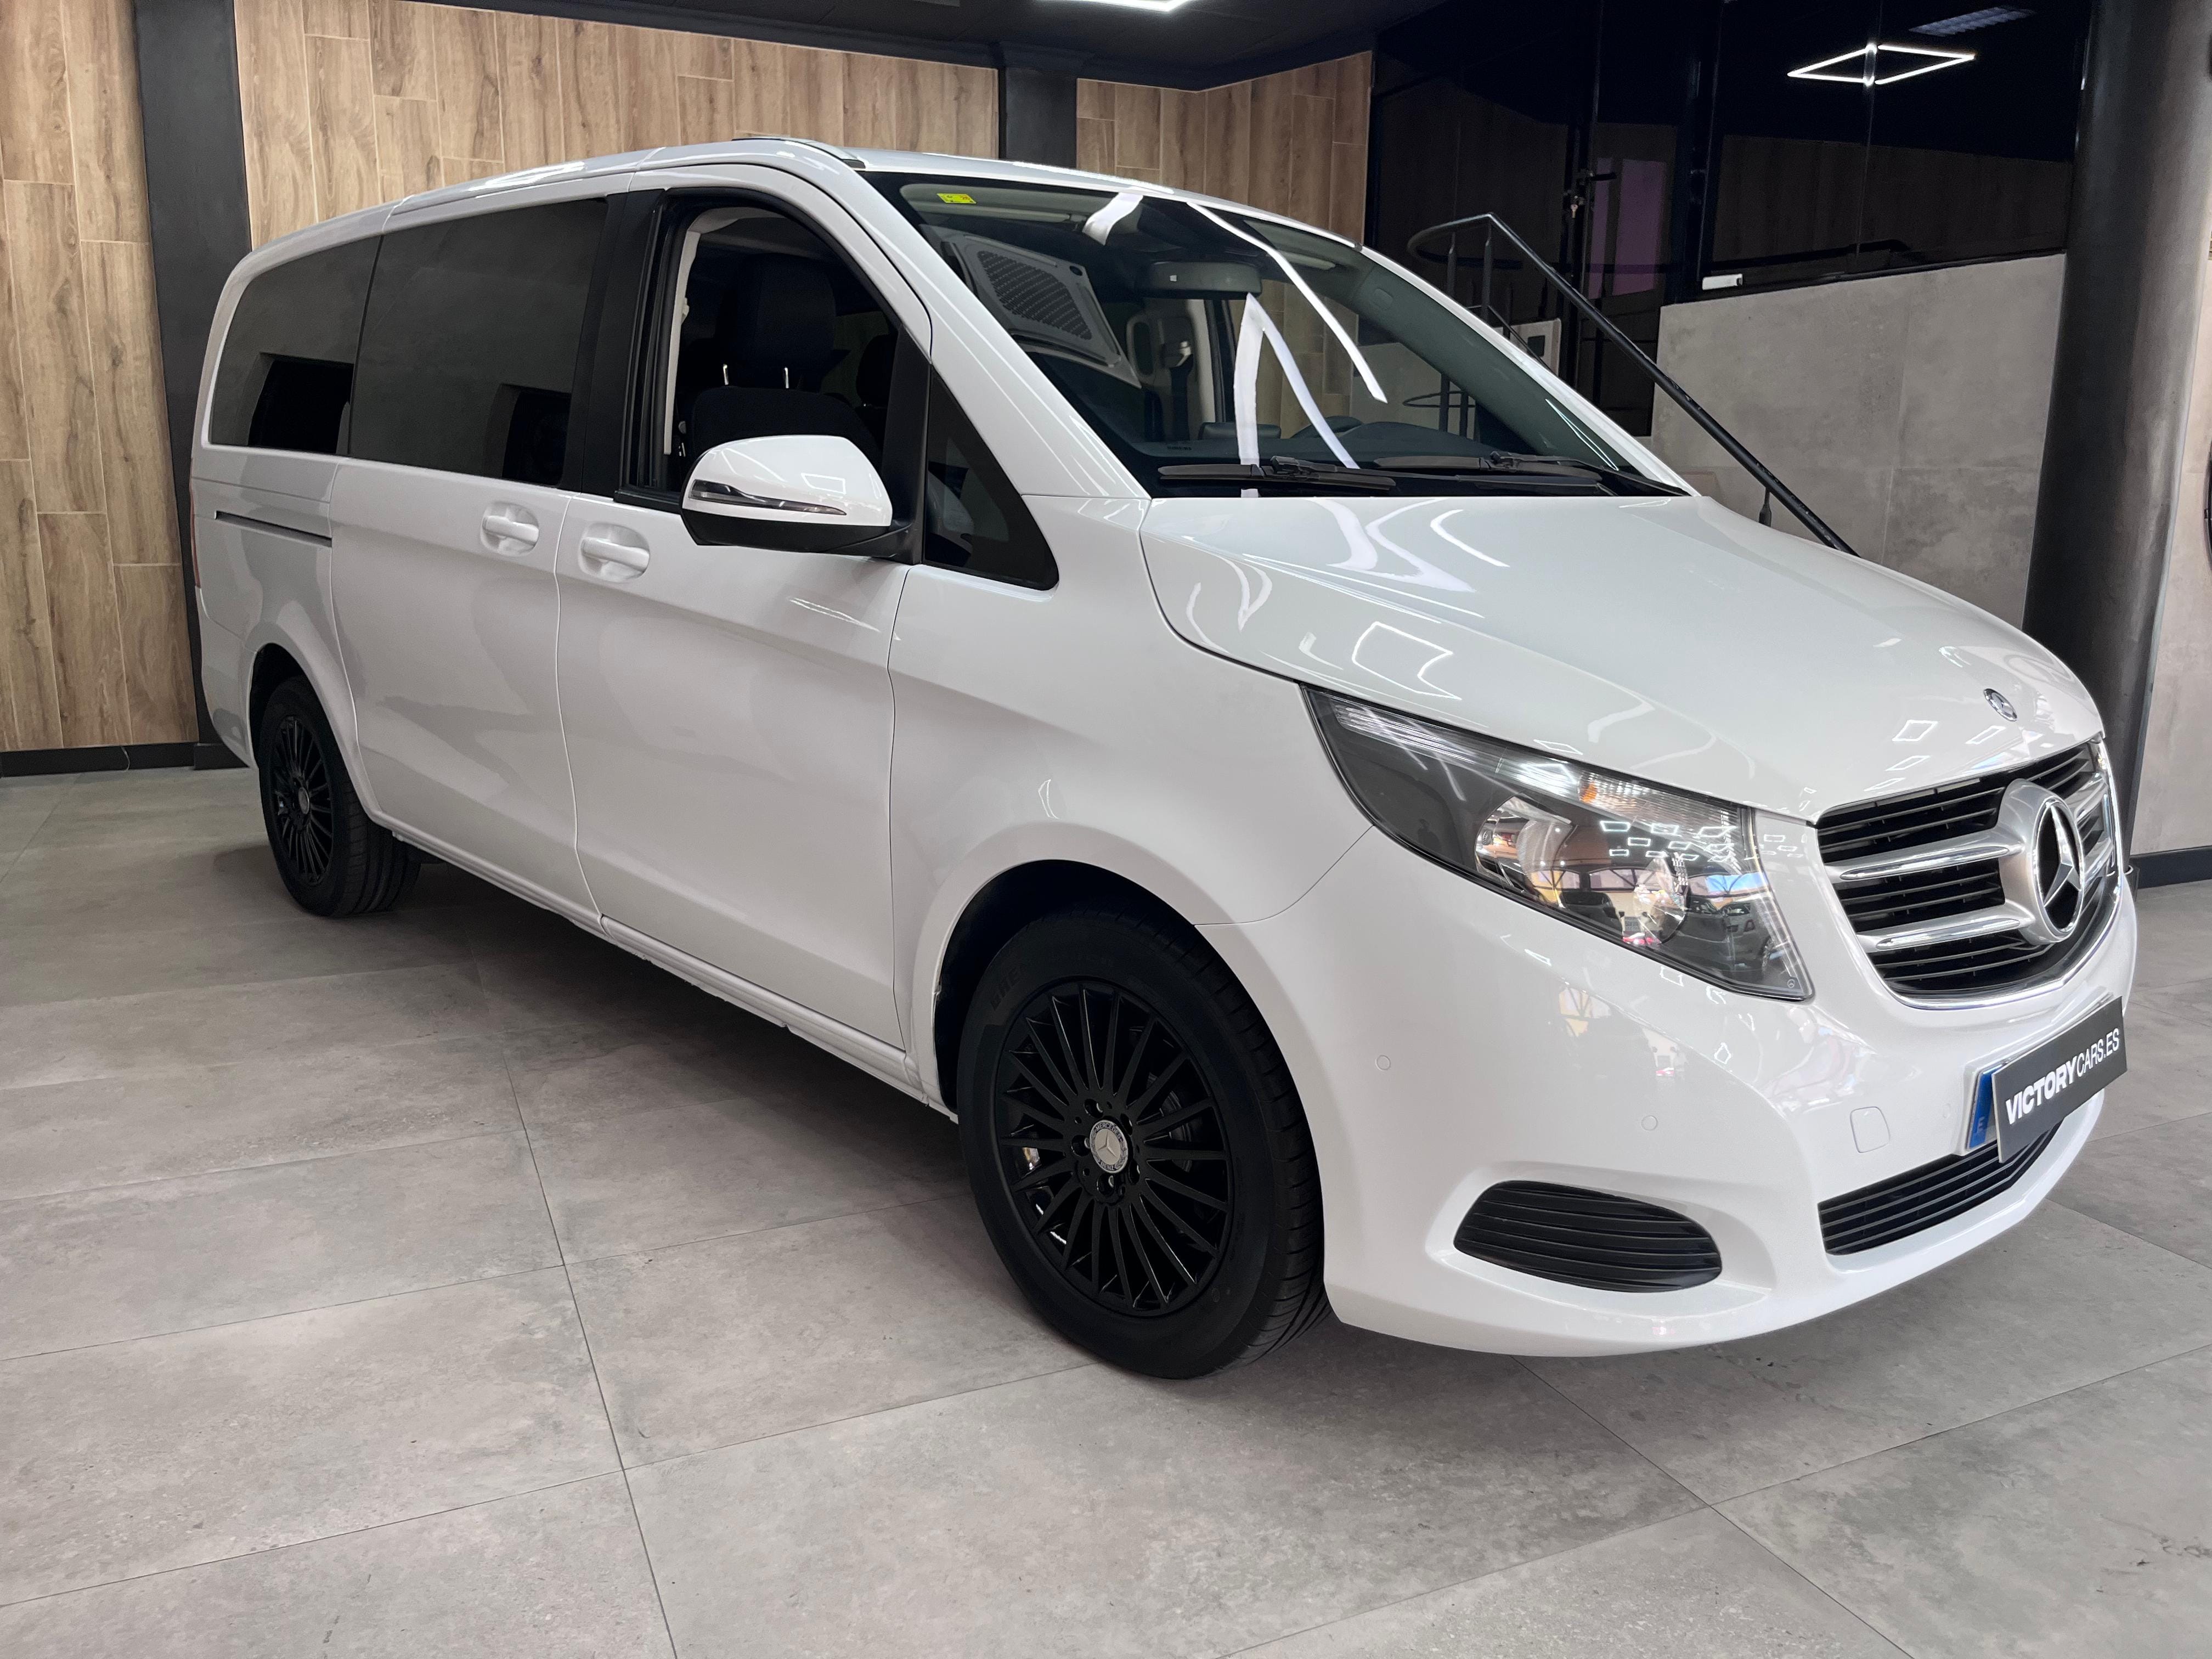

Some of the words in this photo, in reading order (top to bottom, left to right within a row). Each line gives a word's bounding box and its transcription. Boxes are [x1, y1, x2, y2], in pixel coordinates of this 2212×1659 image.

[2006, 1028, 2119, 1125] VICTORYCARS.ES
[1096, 1122, 1121, 1139] MERCEDES
[1977, 1116, 1985, 1132] E
